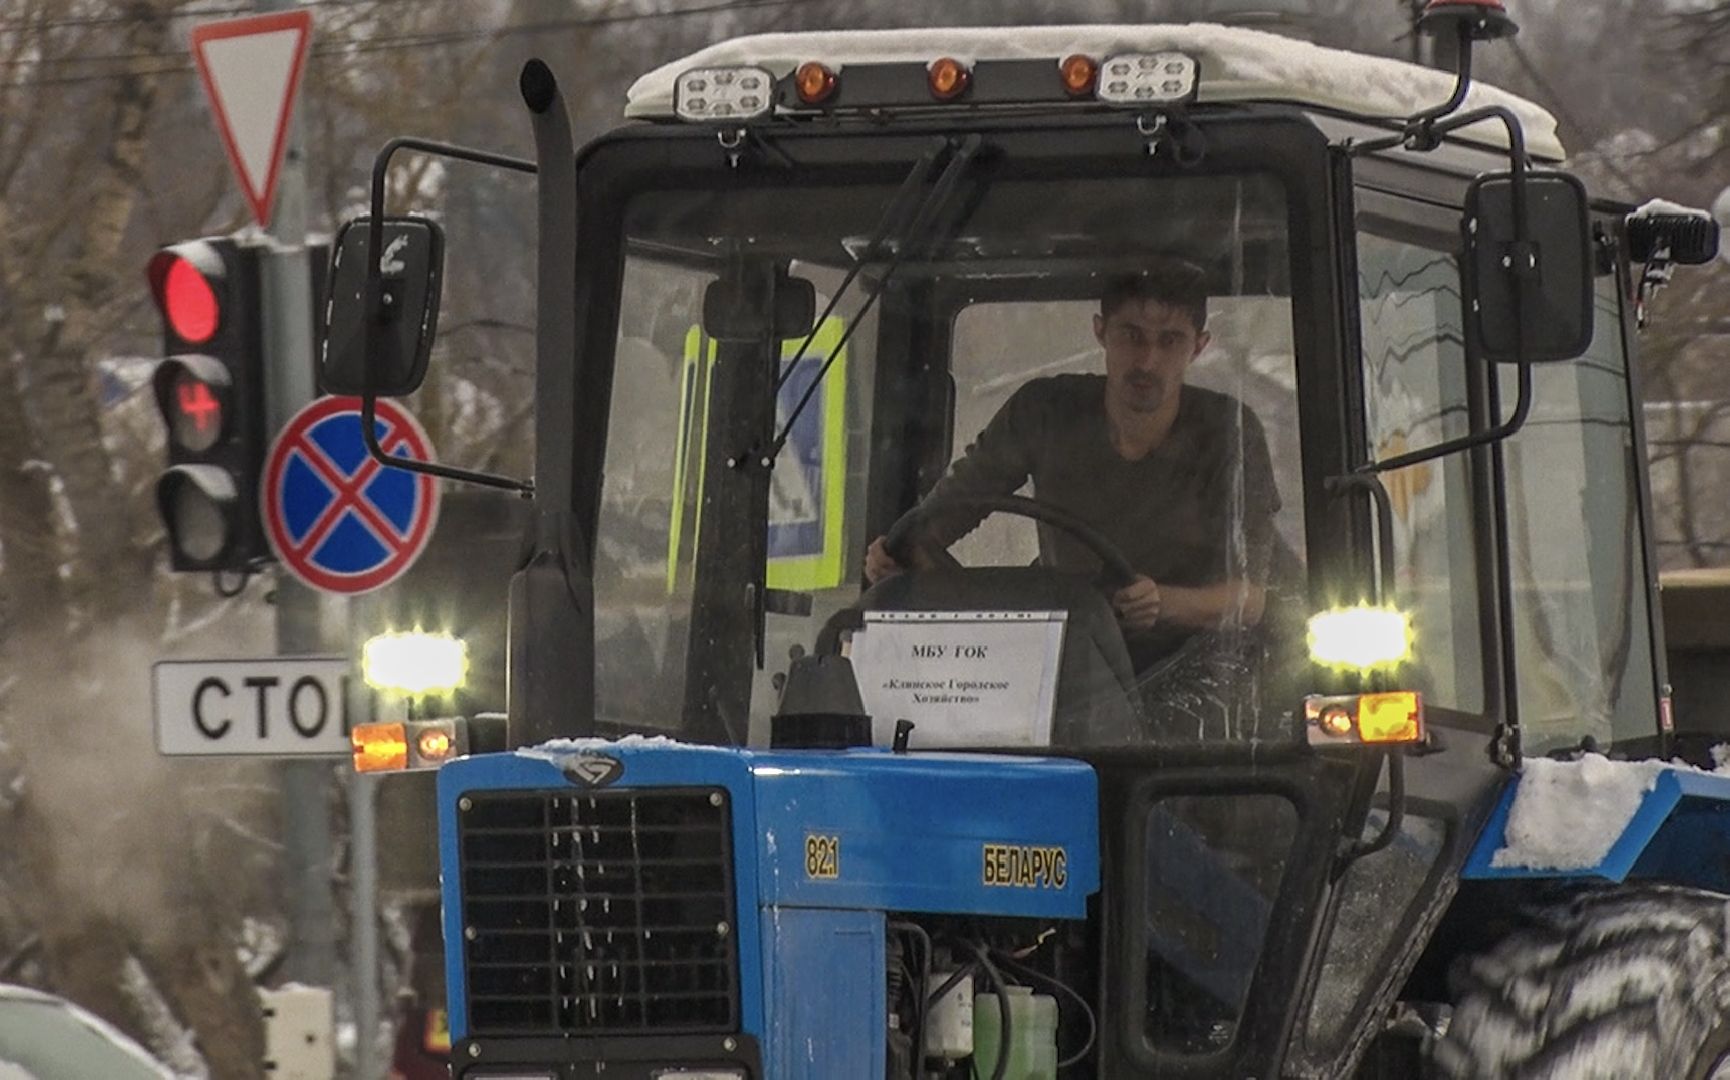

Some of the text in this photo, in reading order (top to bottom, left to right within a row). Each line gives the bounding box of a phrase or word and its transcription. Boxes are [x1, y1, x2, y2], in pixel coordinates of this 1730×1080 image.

[911, 645, 988, 659] МБУ ГОК
[982, 844, 1066, 889] БЕЛАРУС
